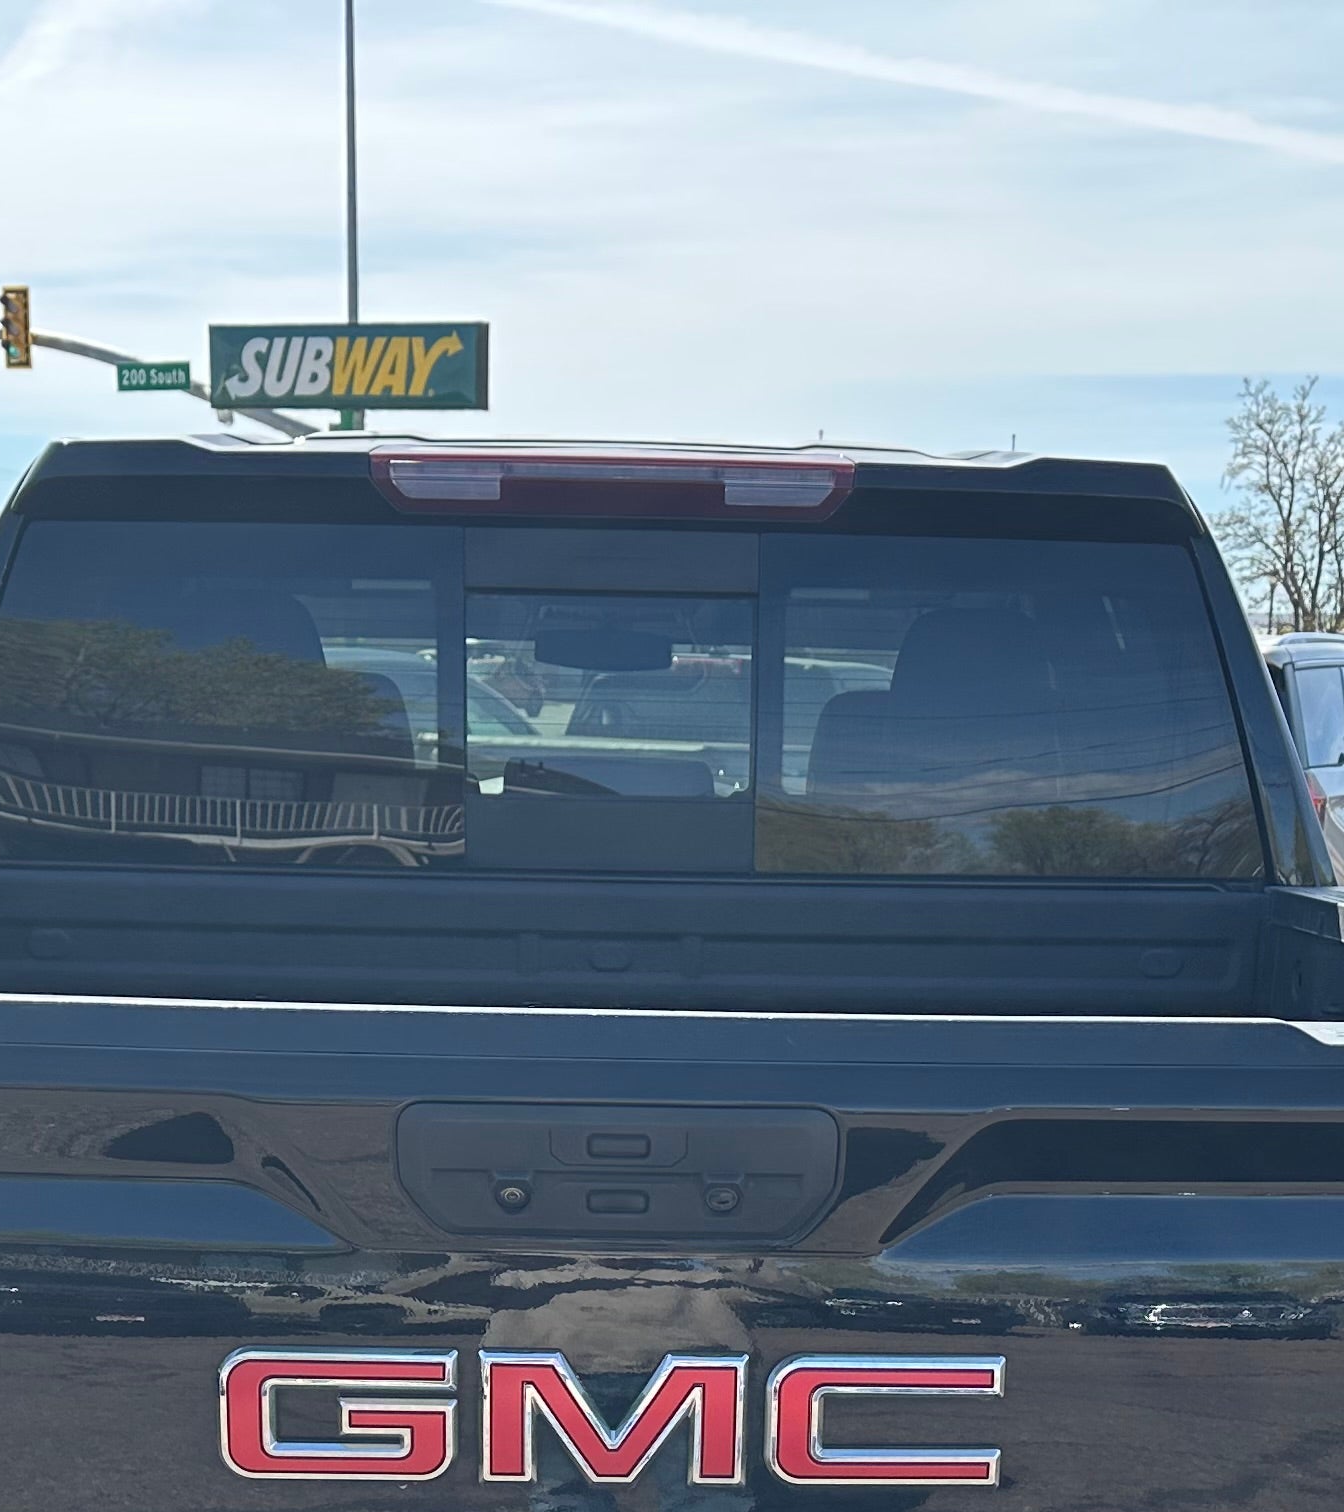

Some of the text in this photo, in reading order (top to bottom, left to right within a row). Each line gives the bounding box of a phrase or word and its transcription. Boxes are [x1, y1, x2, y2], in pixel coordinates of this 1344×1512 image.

[122, 368, 186, 385] 200 South
[225, 329, 464, 400] SUBWAY
[218, 1346, 1007, 1486] GMC
